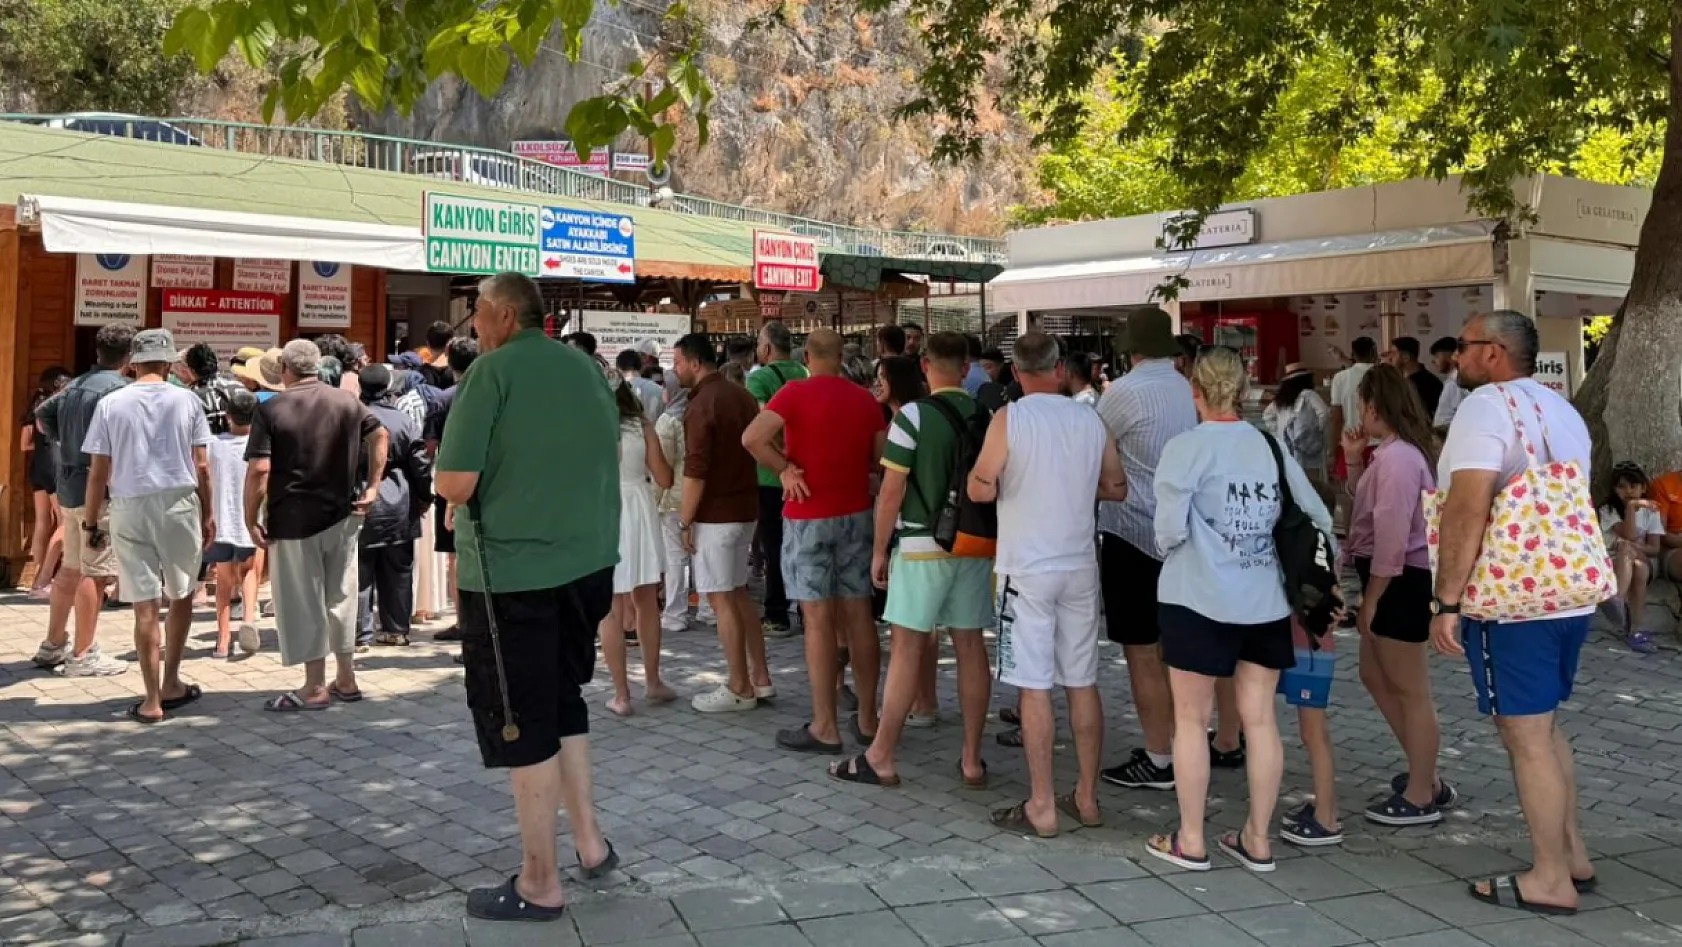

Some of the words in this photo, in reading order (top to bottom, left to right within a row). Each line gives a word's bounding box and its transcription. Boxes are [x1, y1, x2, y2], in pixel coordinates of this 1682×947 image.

[433, 202, 495, 233] KANYON
[498, 205, 536, 239] GİRİŞ
[556, 212, 591, 225] KANYON
[546, 237, 572, 249] SATIN
[760, 238, 793, 258] KANYON
[430, 240, 493, 270] CANYON
[495, 244, 538, 272] ENTER
[82, 279, 108, 287] BARET
[110, 279, 141, 288] TAKMAK
[762, 265, 794, 286] CANYON
[796, 268, 813, 287] EXIT
[84, 300, 115, 309] Wearing
[122, 301, 137, 309] hard
[169, 293, 208, 309] DİKKAT
[218, 295, 275, 311] ATTENTİON
[304, 303, 327, 312] Wearing
[333, 303, 346, 311] hard
[80, 310, 91, 318] hat
[1534, 359, 1564, 376] iriş
